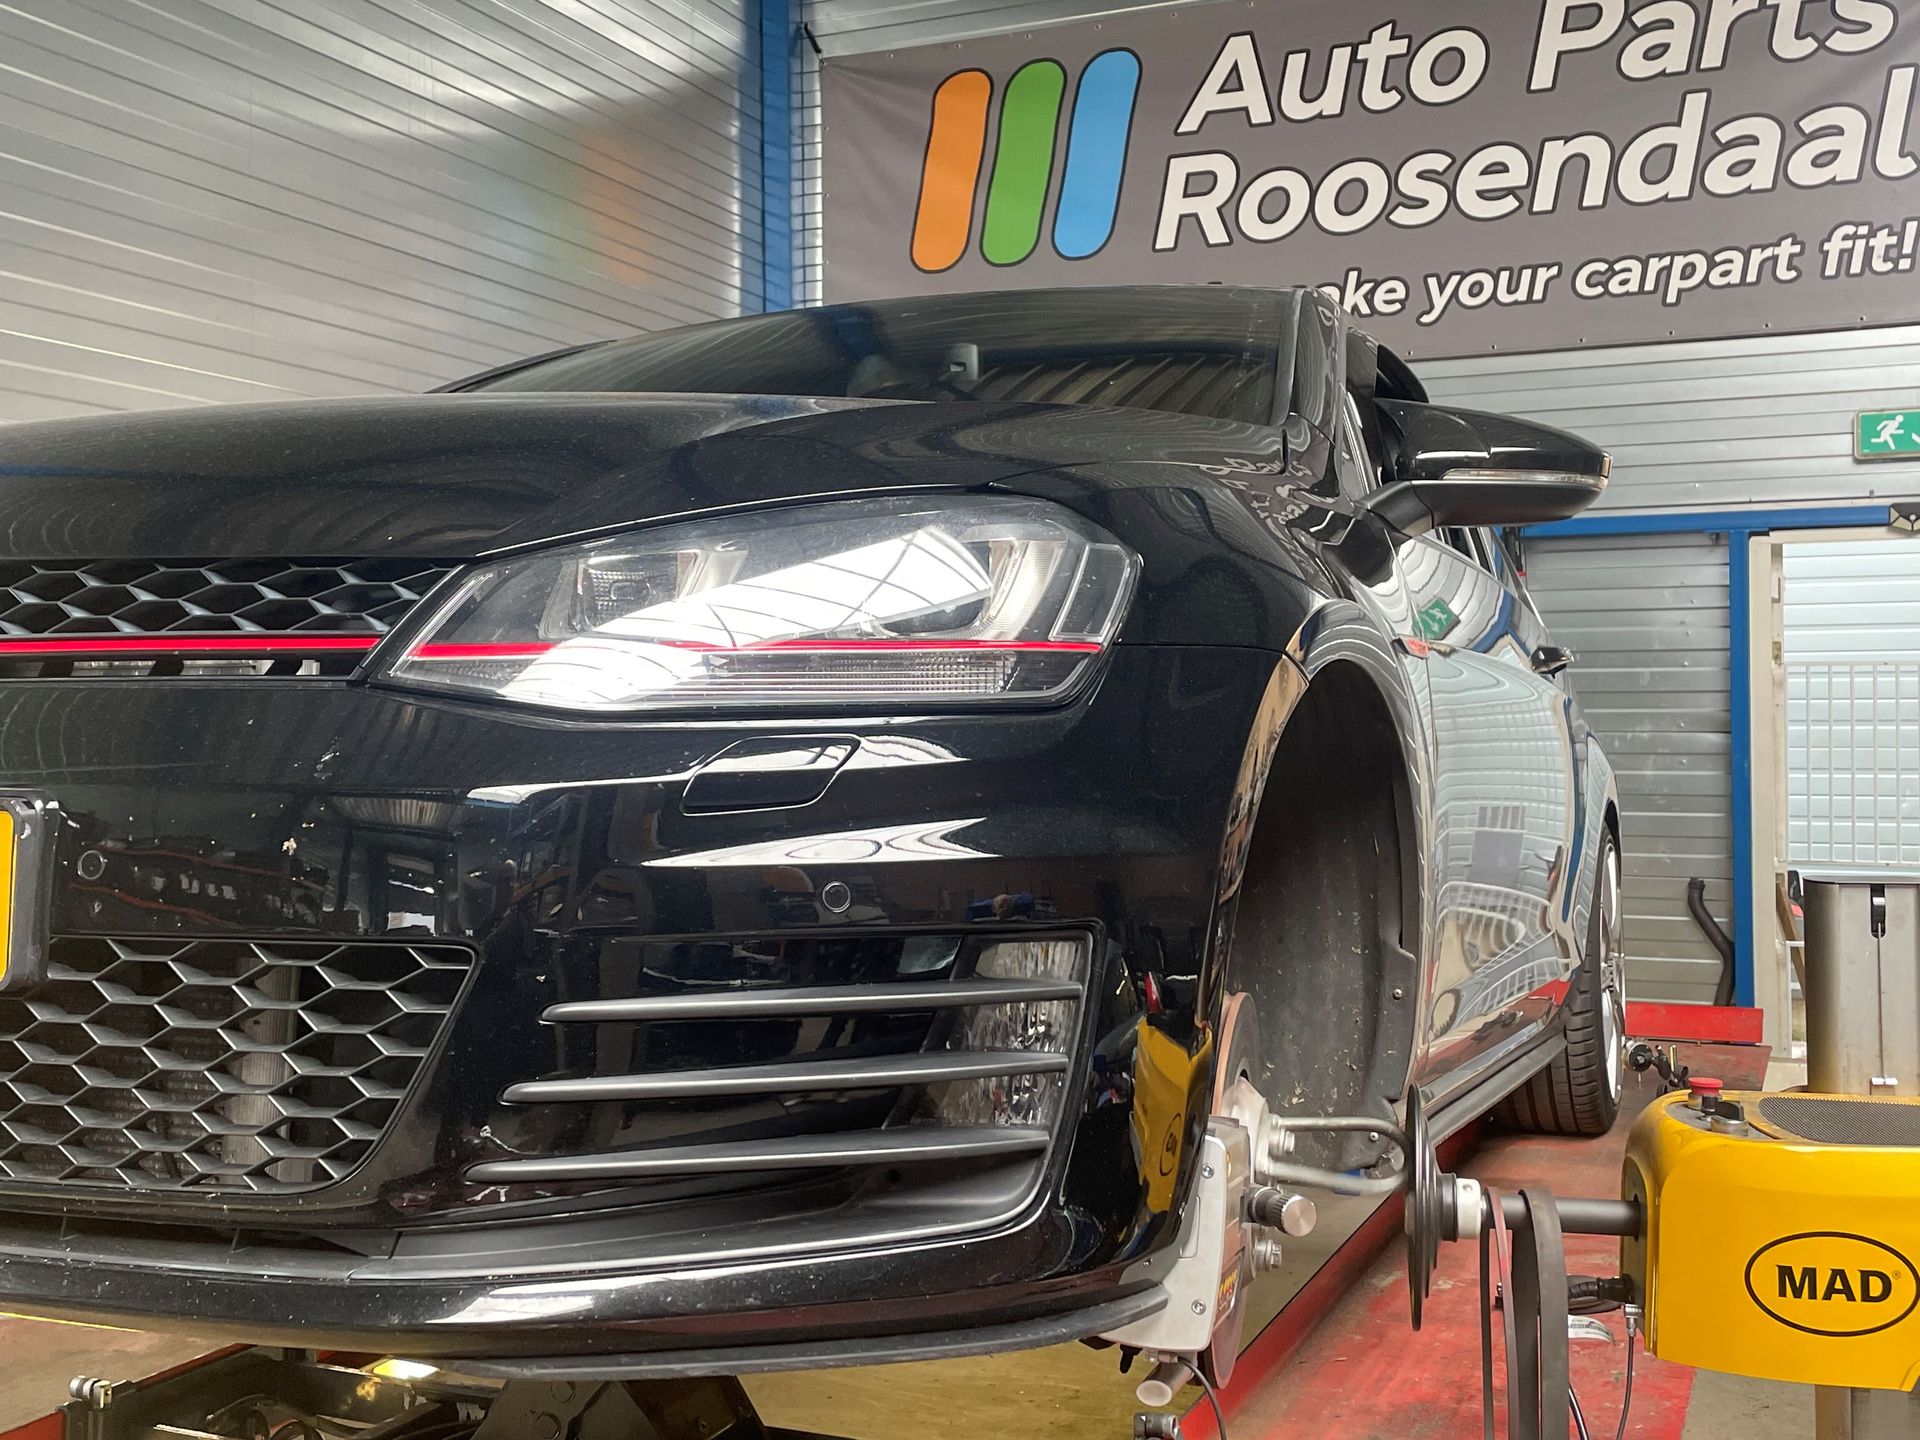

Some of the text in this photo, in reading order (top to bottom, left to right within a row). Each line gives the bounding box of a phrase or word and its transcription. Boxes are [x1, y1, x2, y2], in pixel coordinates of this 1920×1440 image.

[1176, 0, 1896, 134] Auto Parts
[1154, 67, 1919, 250] Roosendaal
[1418, 264, 1558, 324] your
[1575, 236, 1800, 304] carpart
[1822, 220, 1919, 277] fit!
[1775, 1263, 1894, 1303] MAD
